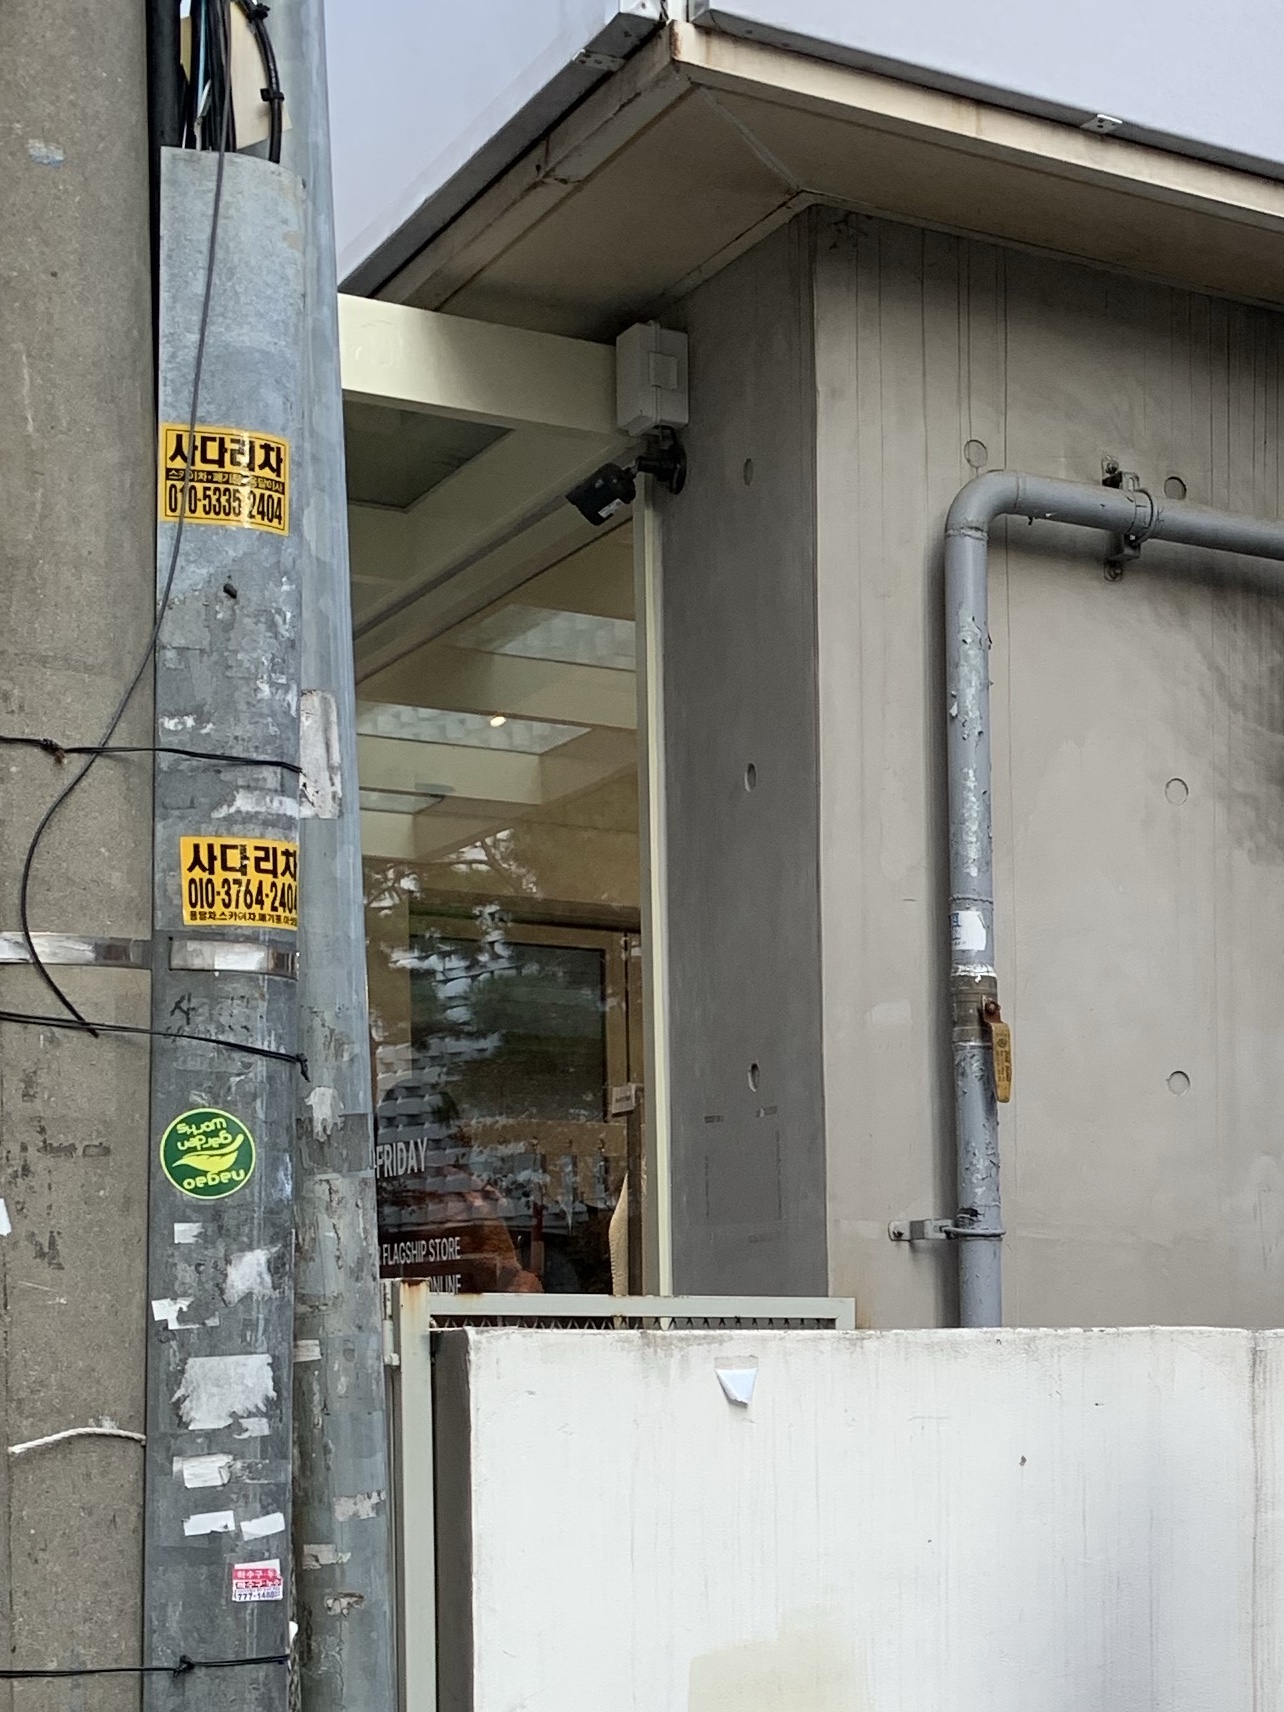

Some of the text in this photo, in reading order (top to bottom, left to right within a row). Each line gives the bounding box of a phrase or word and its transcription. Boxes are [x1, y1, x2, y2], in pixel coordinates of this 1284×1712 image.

[169, 433, 283, 478] 사다리차
[187, 843, 298, 882] 사다리차
[177, 1130, 233, 1150] garden
[183, 1169, 245, 1190] nagao
[382, 1236, 461, 1266] FLAGSHIP STORE
